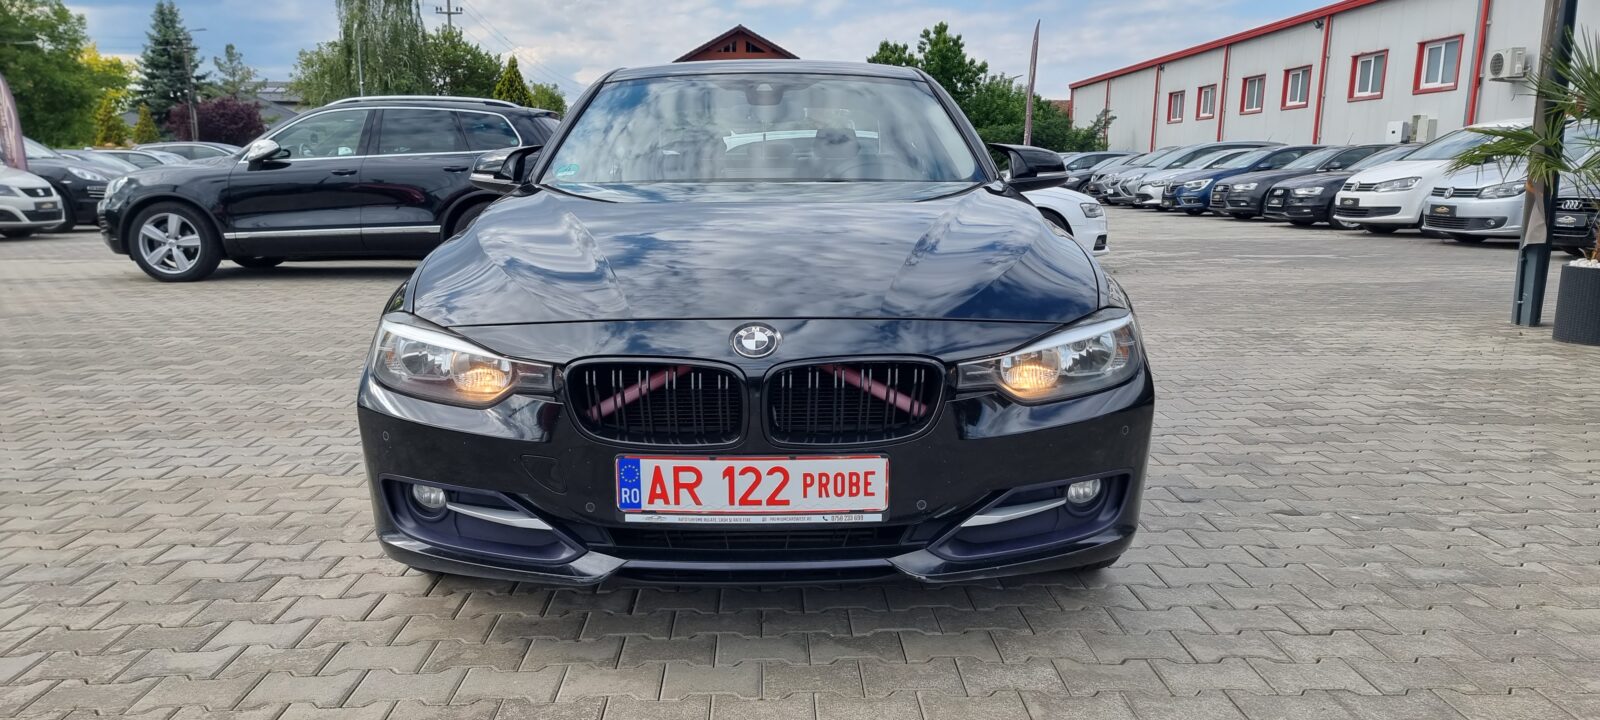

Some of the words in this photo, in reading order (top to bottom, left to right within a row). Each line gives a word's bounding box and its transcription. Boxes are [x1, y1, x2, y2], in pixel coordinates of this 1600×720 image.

[738, 325, 774, 337] BMW
[647, 465, 703, 506] AR
[722, 465, 790, 506] 122
[802, 471, 876, 499] PROBE
[621, 488, 640, 503] RO
